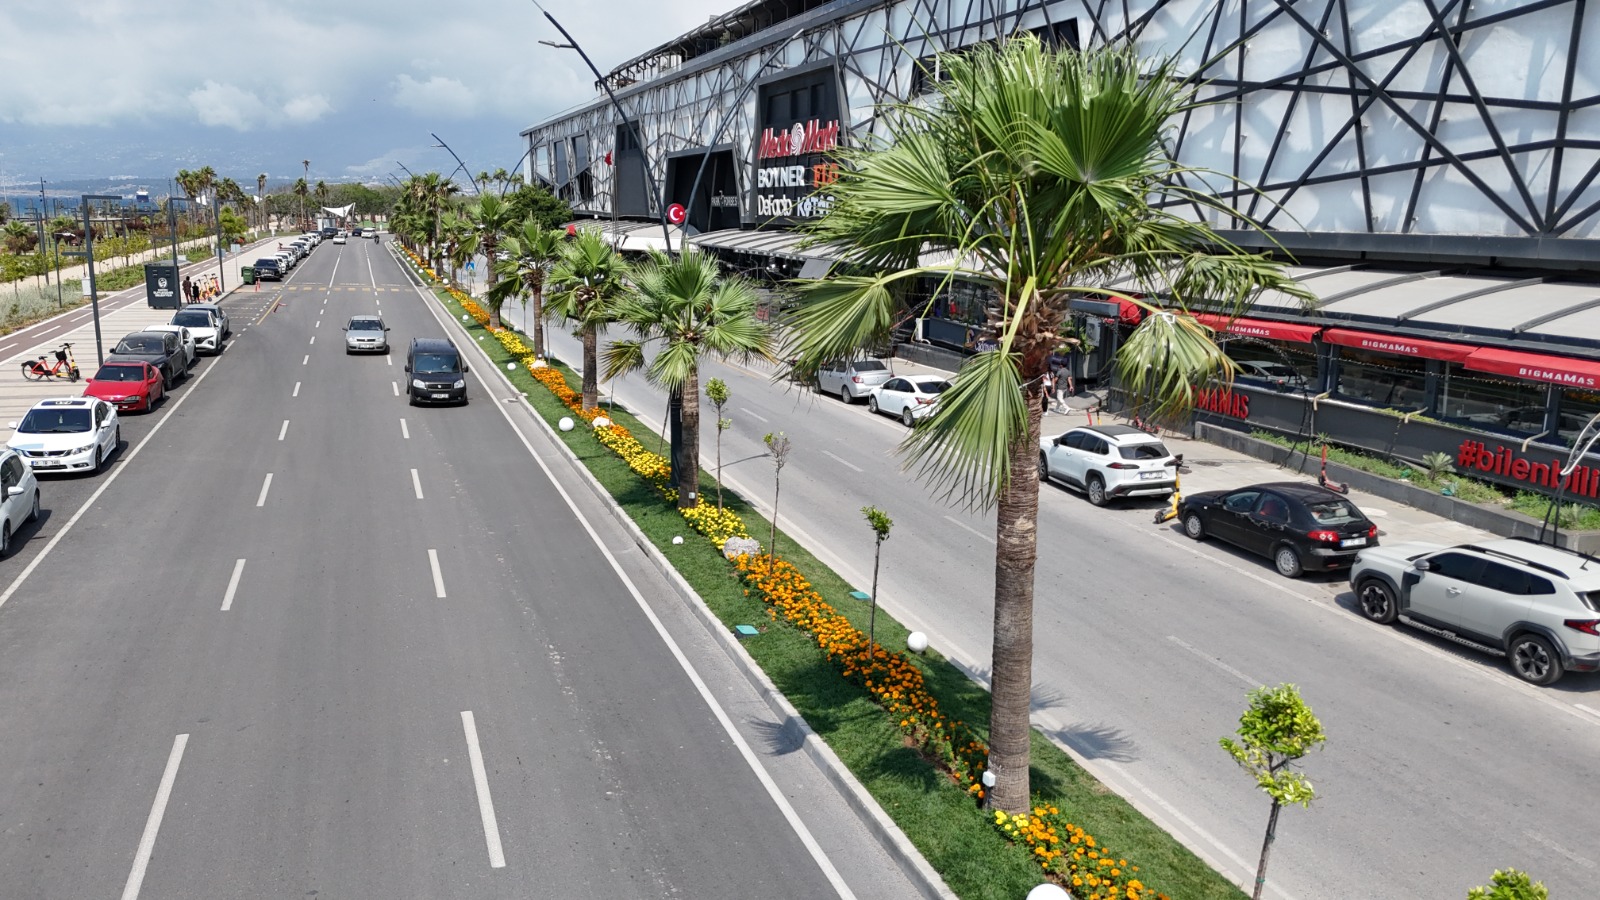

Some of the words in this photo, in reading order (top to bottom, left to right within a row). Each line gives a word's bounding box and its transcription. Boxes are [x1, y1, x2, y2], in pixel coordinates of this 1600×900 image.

[758, 165, 805, 188] BOYNER
[757, 194, 793, 216] DeFacto
[1361, 339, 1419, 354] BIGMAMAS
[1518, 367, 1595, 386] BIGMAMAS
[1192, 386, 1249, 419] MAMAS
